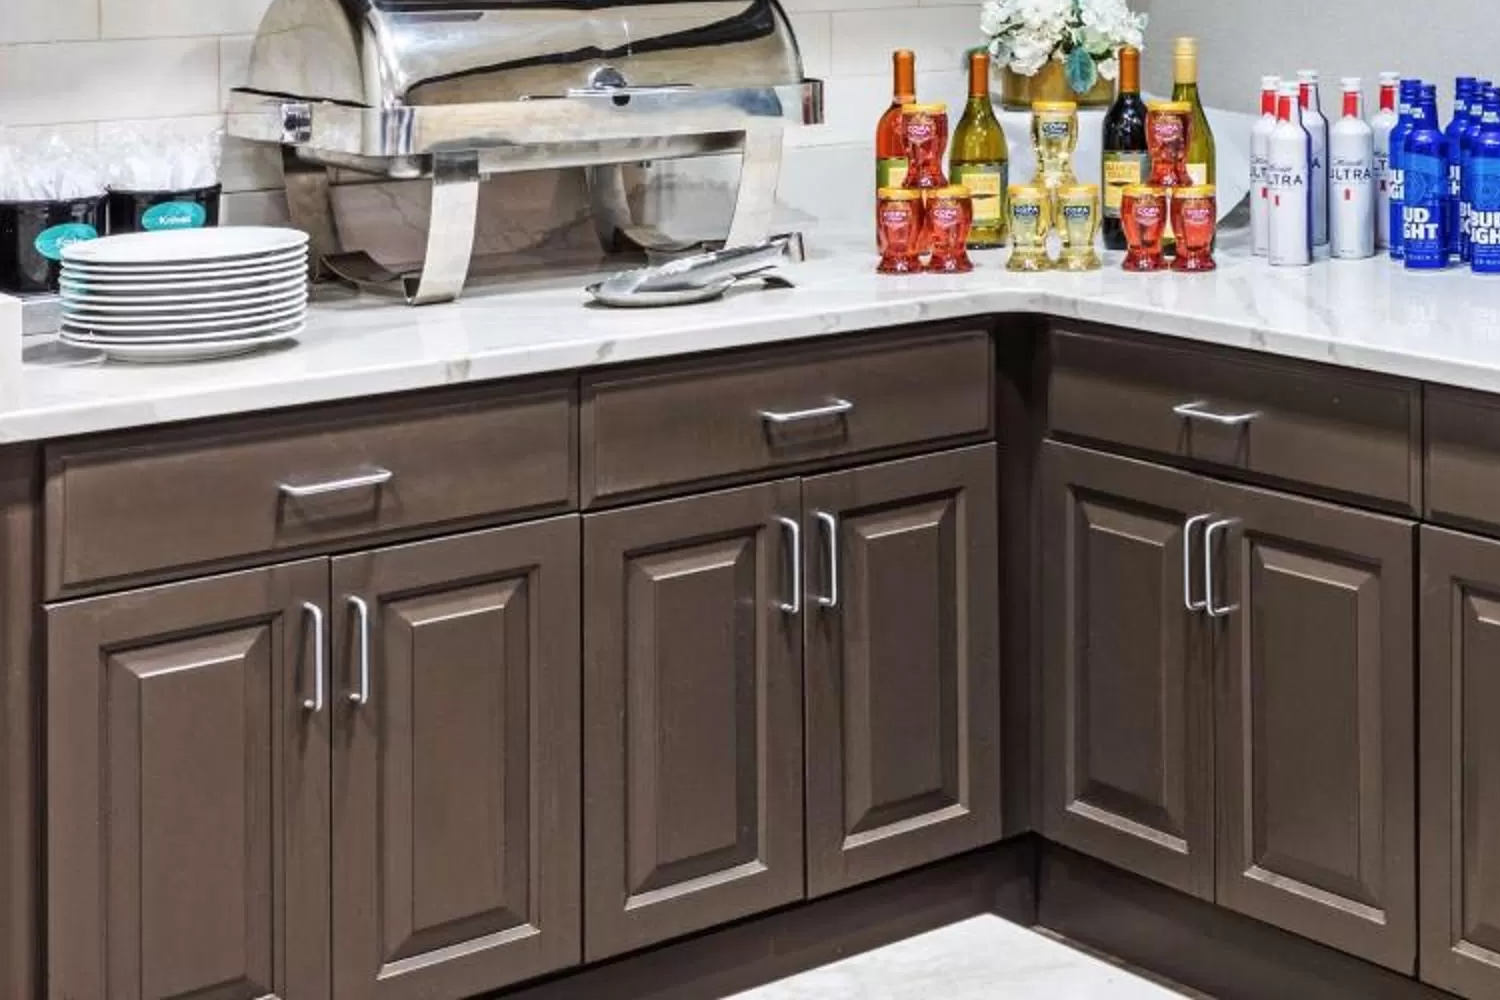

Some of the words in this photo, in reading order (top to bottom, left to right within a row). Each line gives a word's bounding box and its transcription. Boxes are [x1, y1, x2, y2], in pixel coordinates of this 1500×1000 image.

[1267, 173, 1303, 186] LTRA
[1403, 204, 1431, 224] UD
[1403, 222, 1439, 240] GHT
